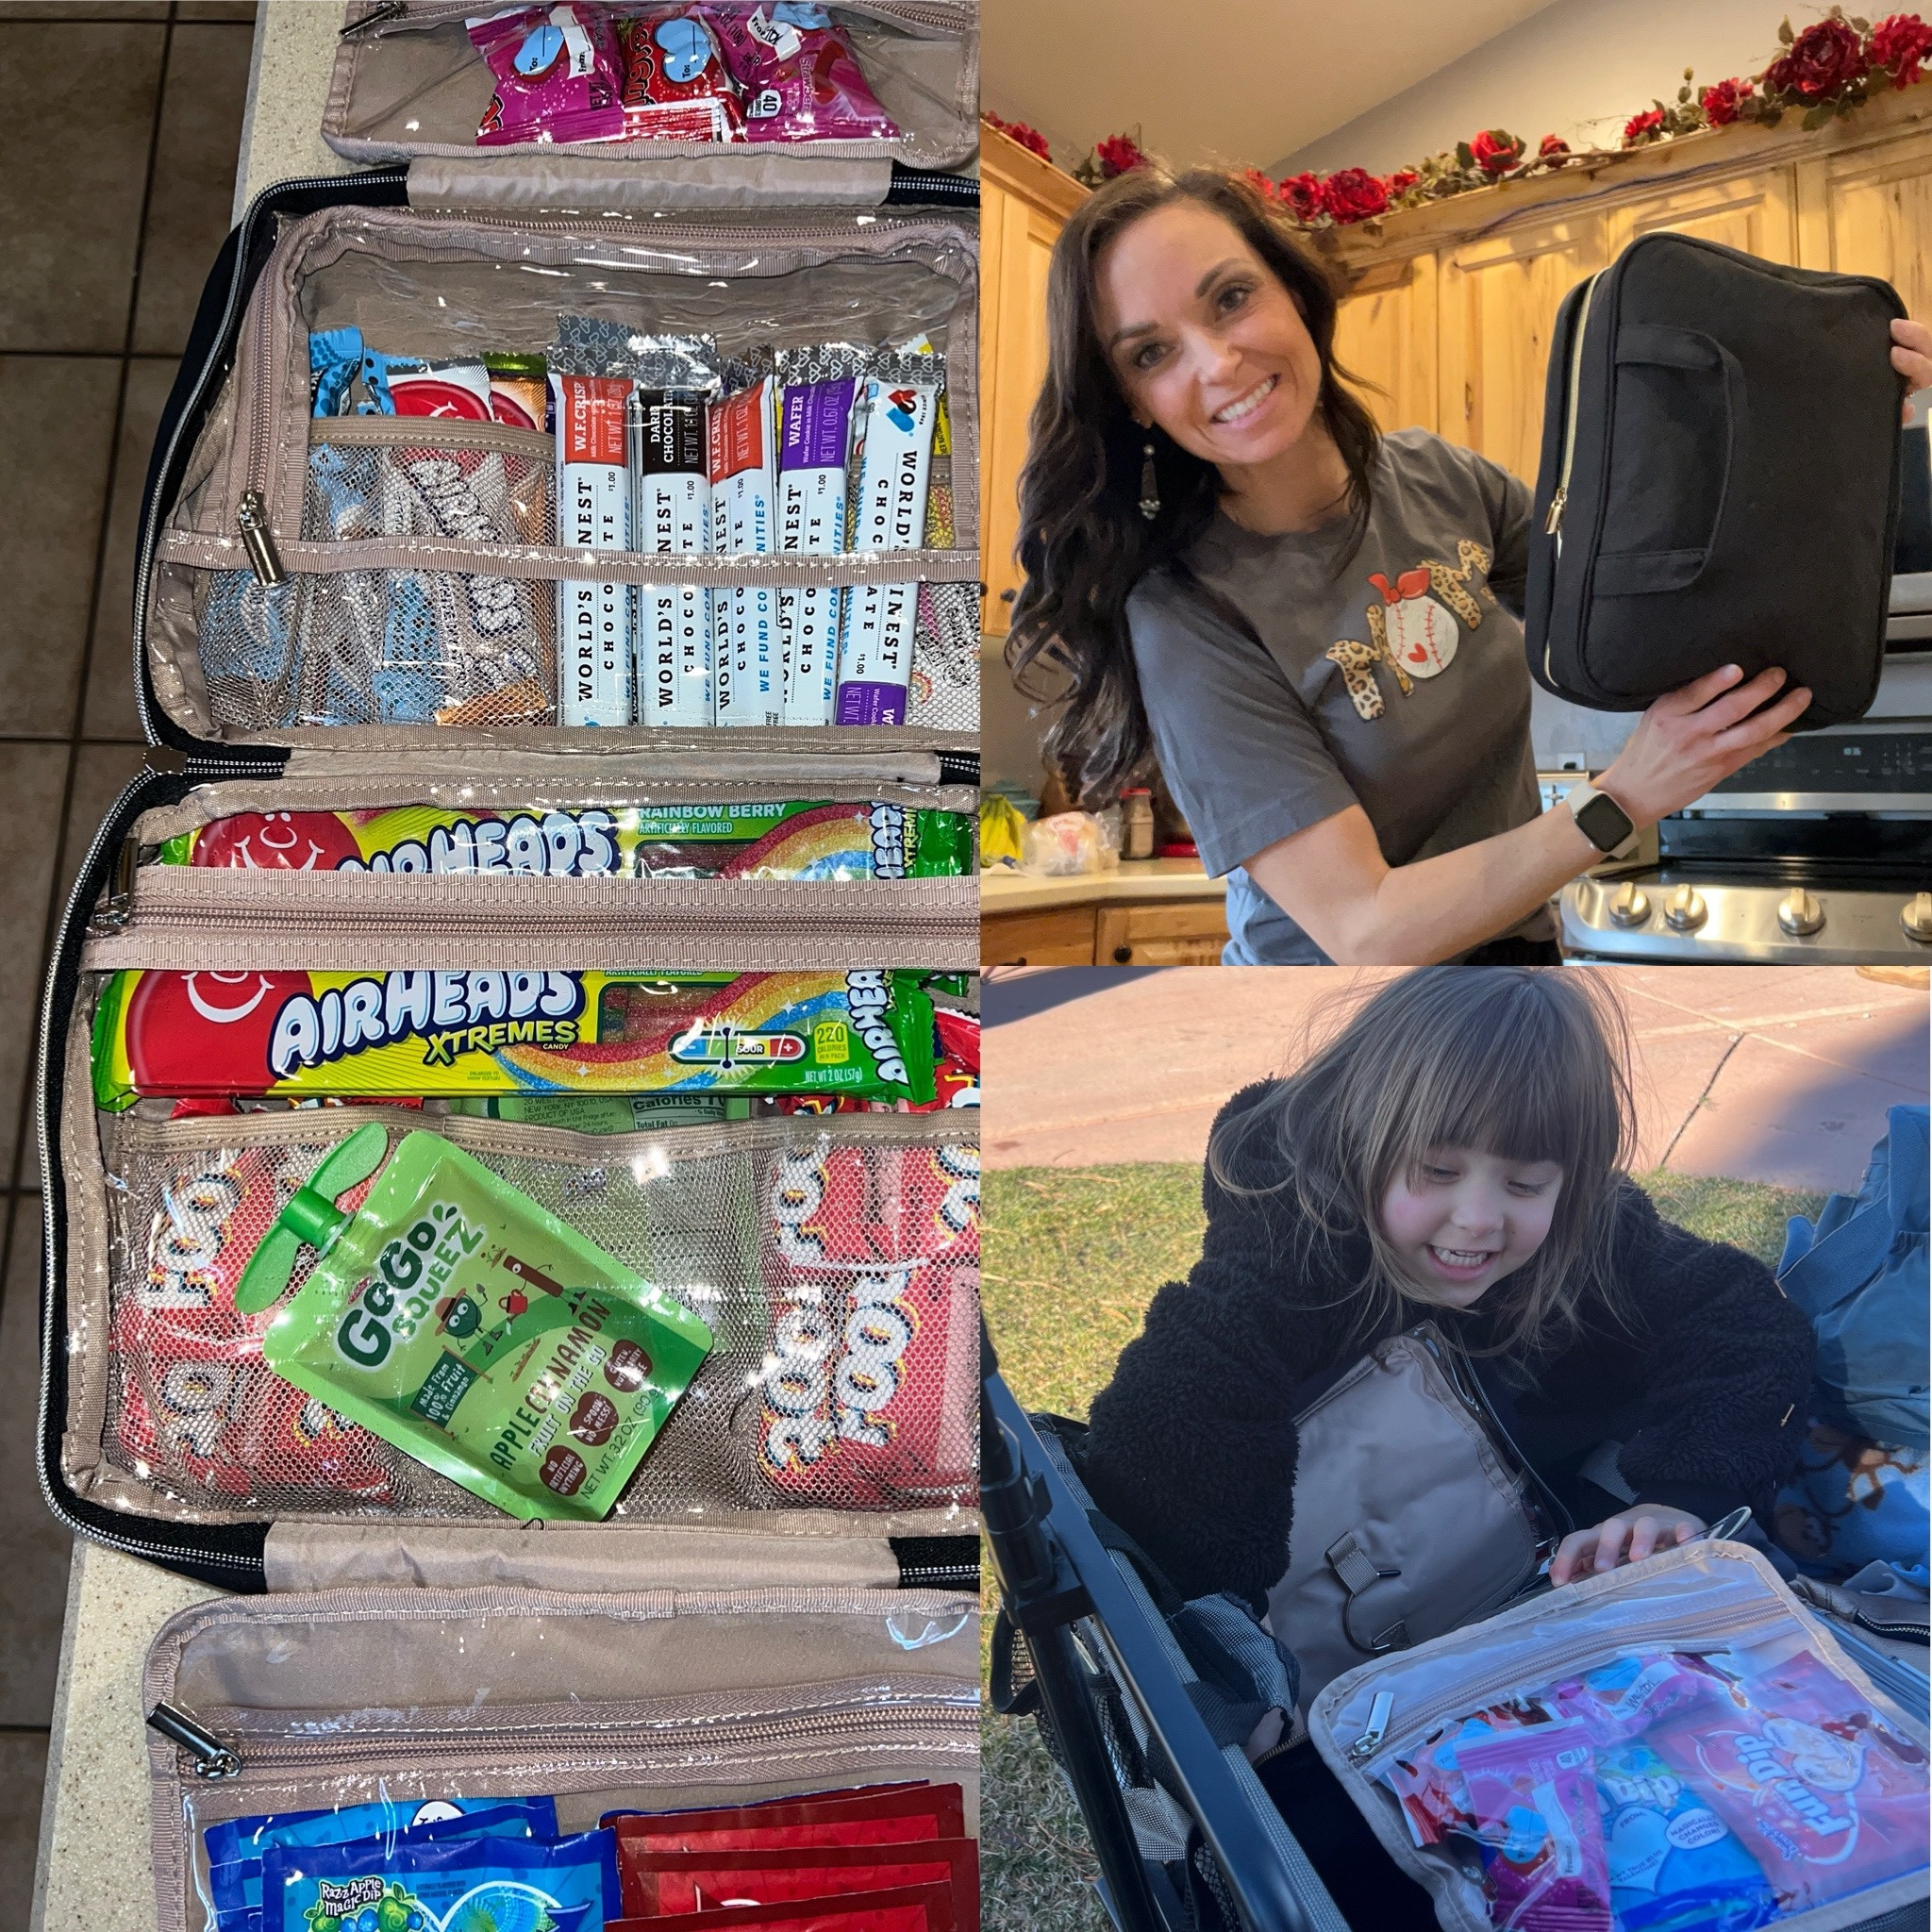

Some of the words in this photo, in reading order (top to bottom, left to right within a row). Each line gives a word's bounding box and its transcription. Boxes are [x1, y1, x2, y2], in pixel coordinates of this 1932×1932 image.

[682, 64, 691, 79] To:
[801, 57, 813, 115] Strawberr
[762, 94, 778, 112] 40
[824, 394, 840, 407] OZ
[574, 381, 587, 452] W.F.CRISP
[650, 408, 662, 443] DARK
[662, 390, 675, 463] CHOCOLATE
[788, 395, 805, 447] WAFER
[823, 407, 839, 425] 0.67
[684, 430, 699, 446] WT.
[736, 425, 748, 441] WT.
[804, 425, 812, 445] Cookie
[821, 427, 837, 446] WT.
[608, 437, 623, 454] NET
[684, 447, 699, 464] NET
[737, 441, 748, 461] NET
[803, 445, 811, 463] Wafer
[820, 445, 836, 462] NET
[608, 472, 616, 491] $1.00
[687, 480, 695, 500] $1.00
[817, 475, 826, 495] $1.00
[577, 481, 592, 545] NEST
[657, 491, 672, 554] NEST
[785, 488, 801, 550] NEST
[715, 499, 727, 554] NEST
[882, 583, 905, 666] INEST
[577, 590, 593, 702] WORLD'S
[624, 626, 632, 669] FUND
[758, 619, 769, 662] FUND
[825, 625, 836, 671] FUND
[658, 597, 674, 708] WORLD'S
[717, 601, 731, 710] WORLD'S
[856, 653, 866, 675] $1.00
[759, 669, 770, 692] WE
[823, 677, 832, 700] WE
[845, 687, 861, 704] NET
[872, 688, 881, 707] Wafer
[842, 703, 860, 724] WT.
[639, 804, 724, 820] RAINBOW
[729, 803, 786, 819] BERRY
[692, 821, 732, 834] FLAVORED
[272, 970, 577, 1076] AIRHEADS
[423, 1019, 579, 1067] XTREMES
[816, 1026, 844, 1044] 220
[737, 1044, 764, 1055] SOUR
[817, 1043, 846, 1053] CALORIES
[805, 1071, 818, 1083] NET
[818, 1071, 827, 1082] WT
[834, 1069, 843, 1082] OZ
[632, 1095, 702, 1110] Calories
[419, 1382, 436, 1408] Made
[431, 1362, 450, 1385] From
[425, 1391, 448, 1421] 100%
[441, 1363, 467, 1394] Fruit
[445, 1375, 470, 1412] Cinnamon
[528, 1413, 562, 1458] FRUIT
[554, 1390, 576, 1416] ON
[569, 1366, 594, 1393] THE
[587, 1344, 607, 1367] GO
[585, 1429, 598, 1443] NO
[594, 1404, 612, 1430] MESS!
[547, 1459, 558, 1473] NO
[579, 1474, 599, 1501] NET
[595, 1456, 613, 1479] WT.
[608, 1434, 627, 1459] 3.2
[621, 1416, 639, 1439] OZ
[548, 1455, 575, 1490] ARTIFICIAL
[563, 1462, 584, 1494] ANYTHING
[1734, 1732, 1790, 1784] Dip
[1774, 1777, 1855, 1838] Fun
[1669, 1814, 1718, 1837] MAGICALLY
[1678, 1820, 1721, 1841] CHANGES
[1687, 1827, 1721, 1845] COLOR!
